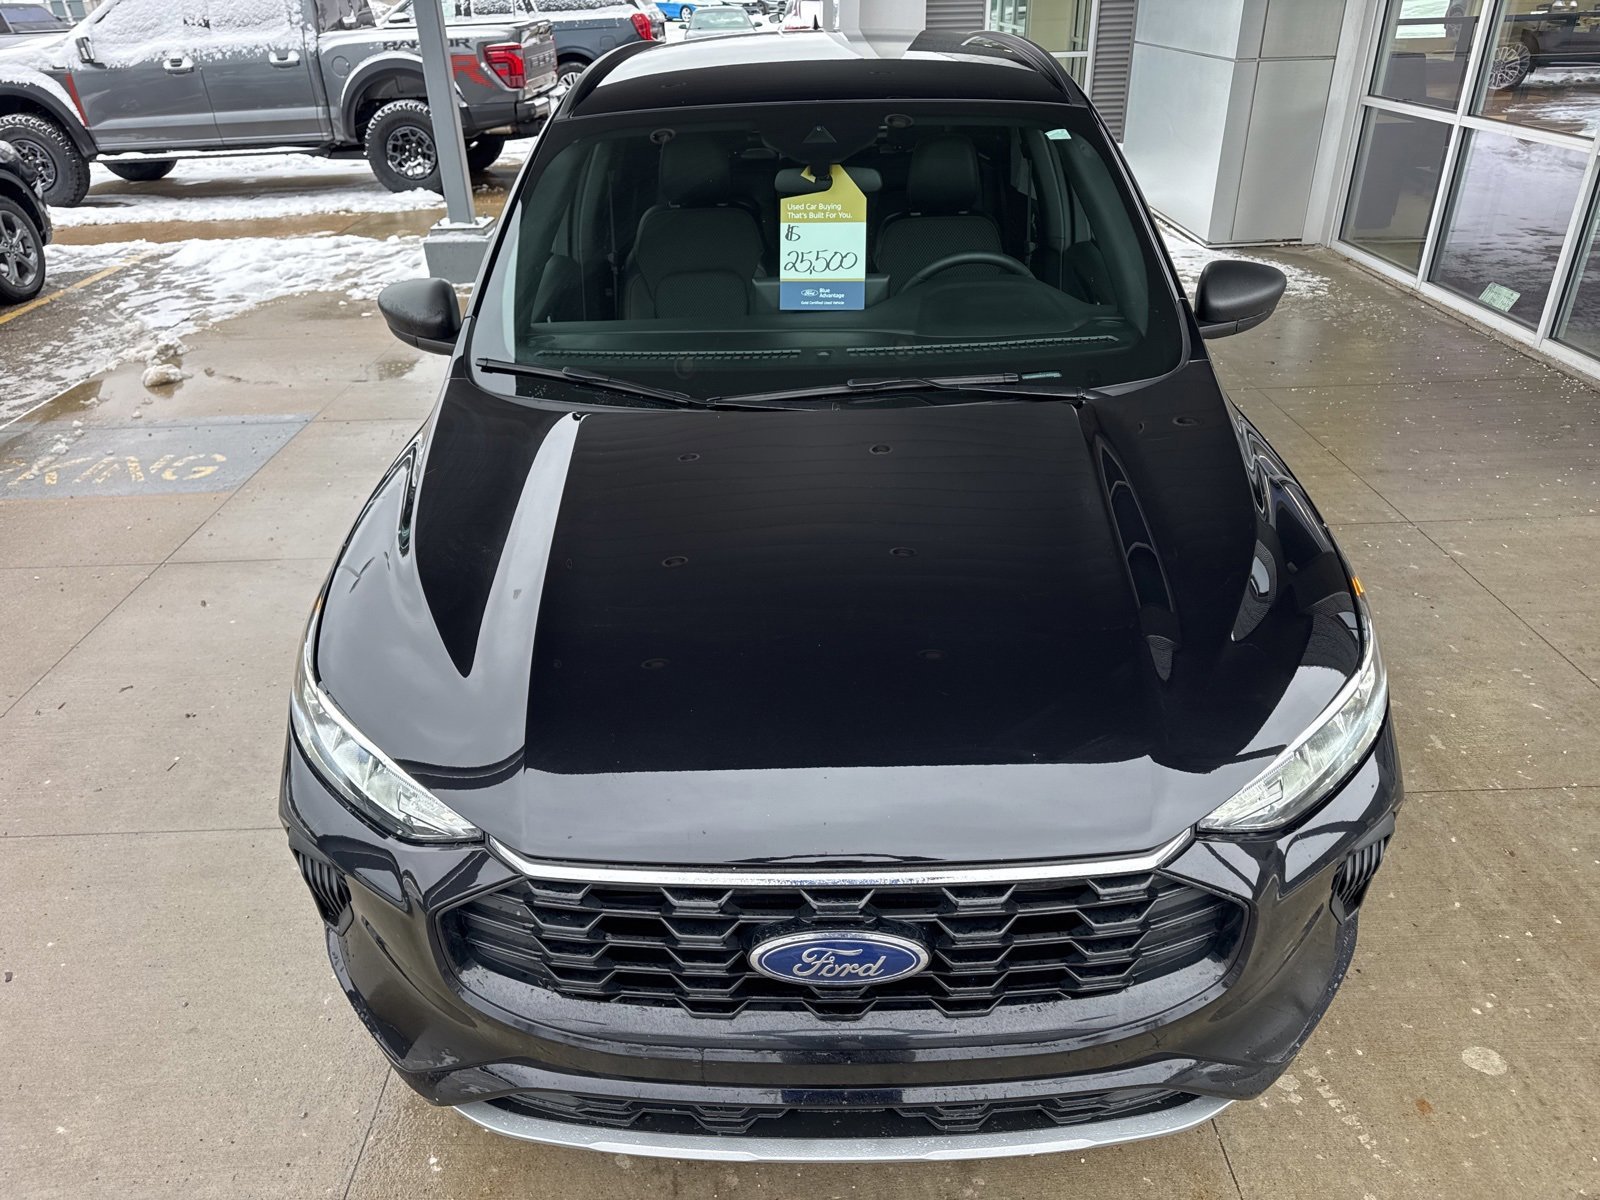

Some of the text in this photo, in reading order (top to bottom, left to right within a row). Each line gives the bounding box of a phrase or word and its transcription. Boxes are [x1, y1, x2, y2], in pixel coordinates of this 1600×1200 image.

[818, 203, 842, 211] Buying
[784, 250, 858, 275] 25,500
[792, 947, 887, 977] Ford
